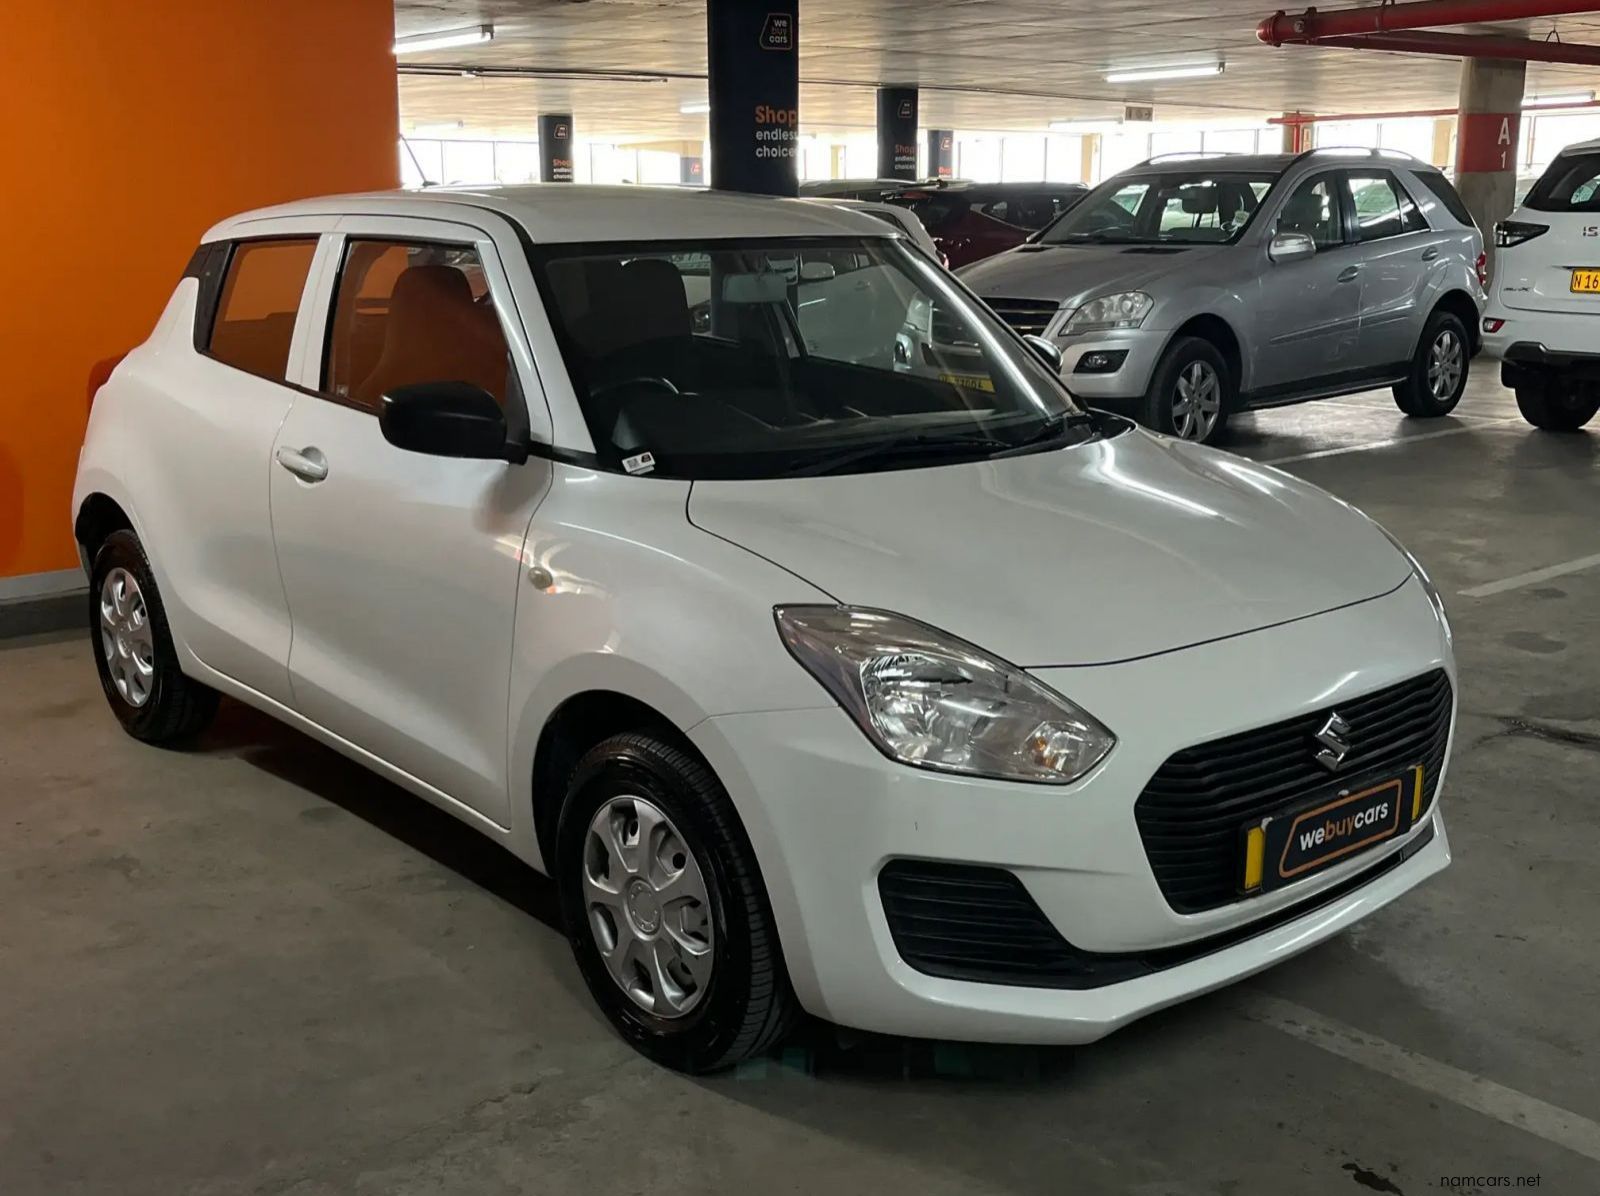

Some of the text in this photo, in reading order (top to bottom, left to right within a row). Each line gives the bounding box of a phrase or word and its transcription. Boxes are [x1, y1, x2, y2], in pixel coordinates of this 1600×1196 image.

[769, 35, 787, 43] cars
[755, 105, 797, 127] Shop
[1497, 117, 1511, 145] A
[1500, 151, 1506, 169] 1
[1300, 802, 1389, 852] webuycars
